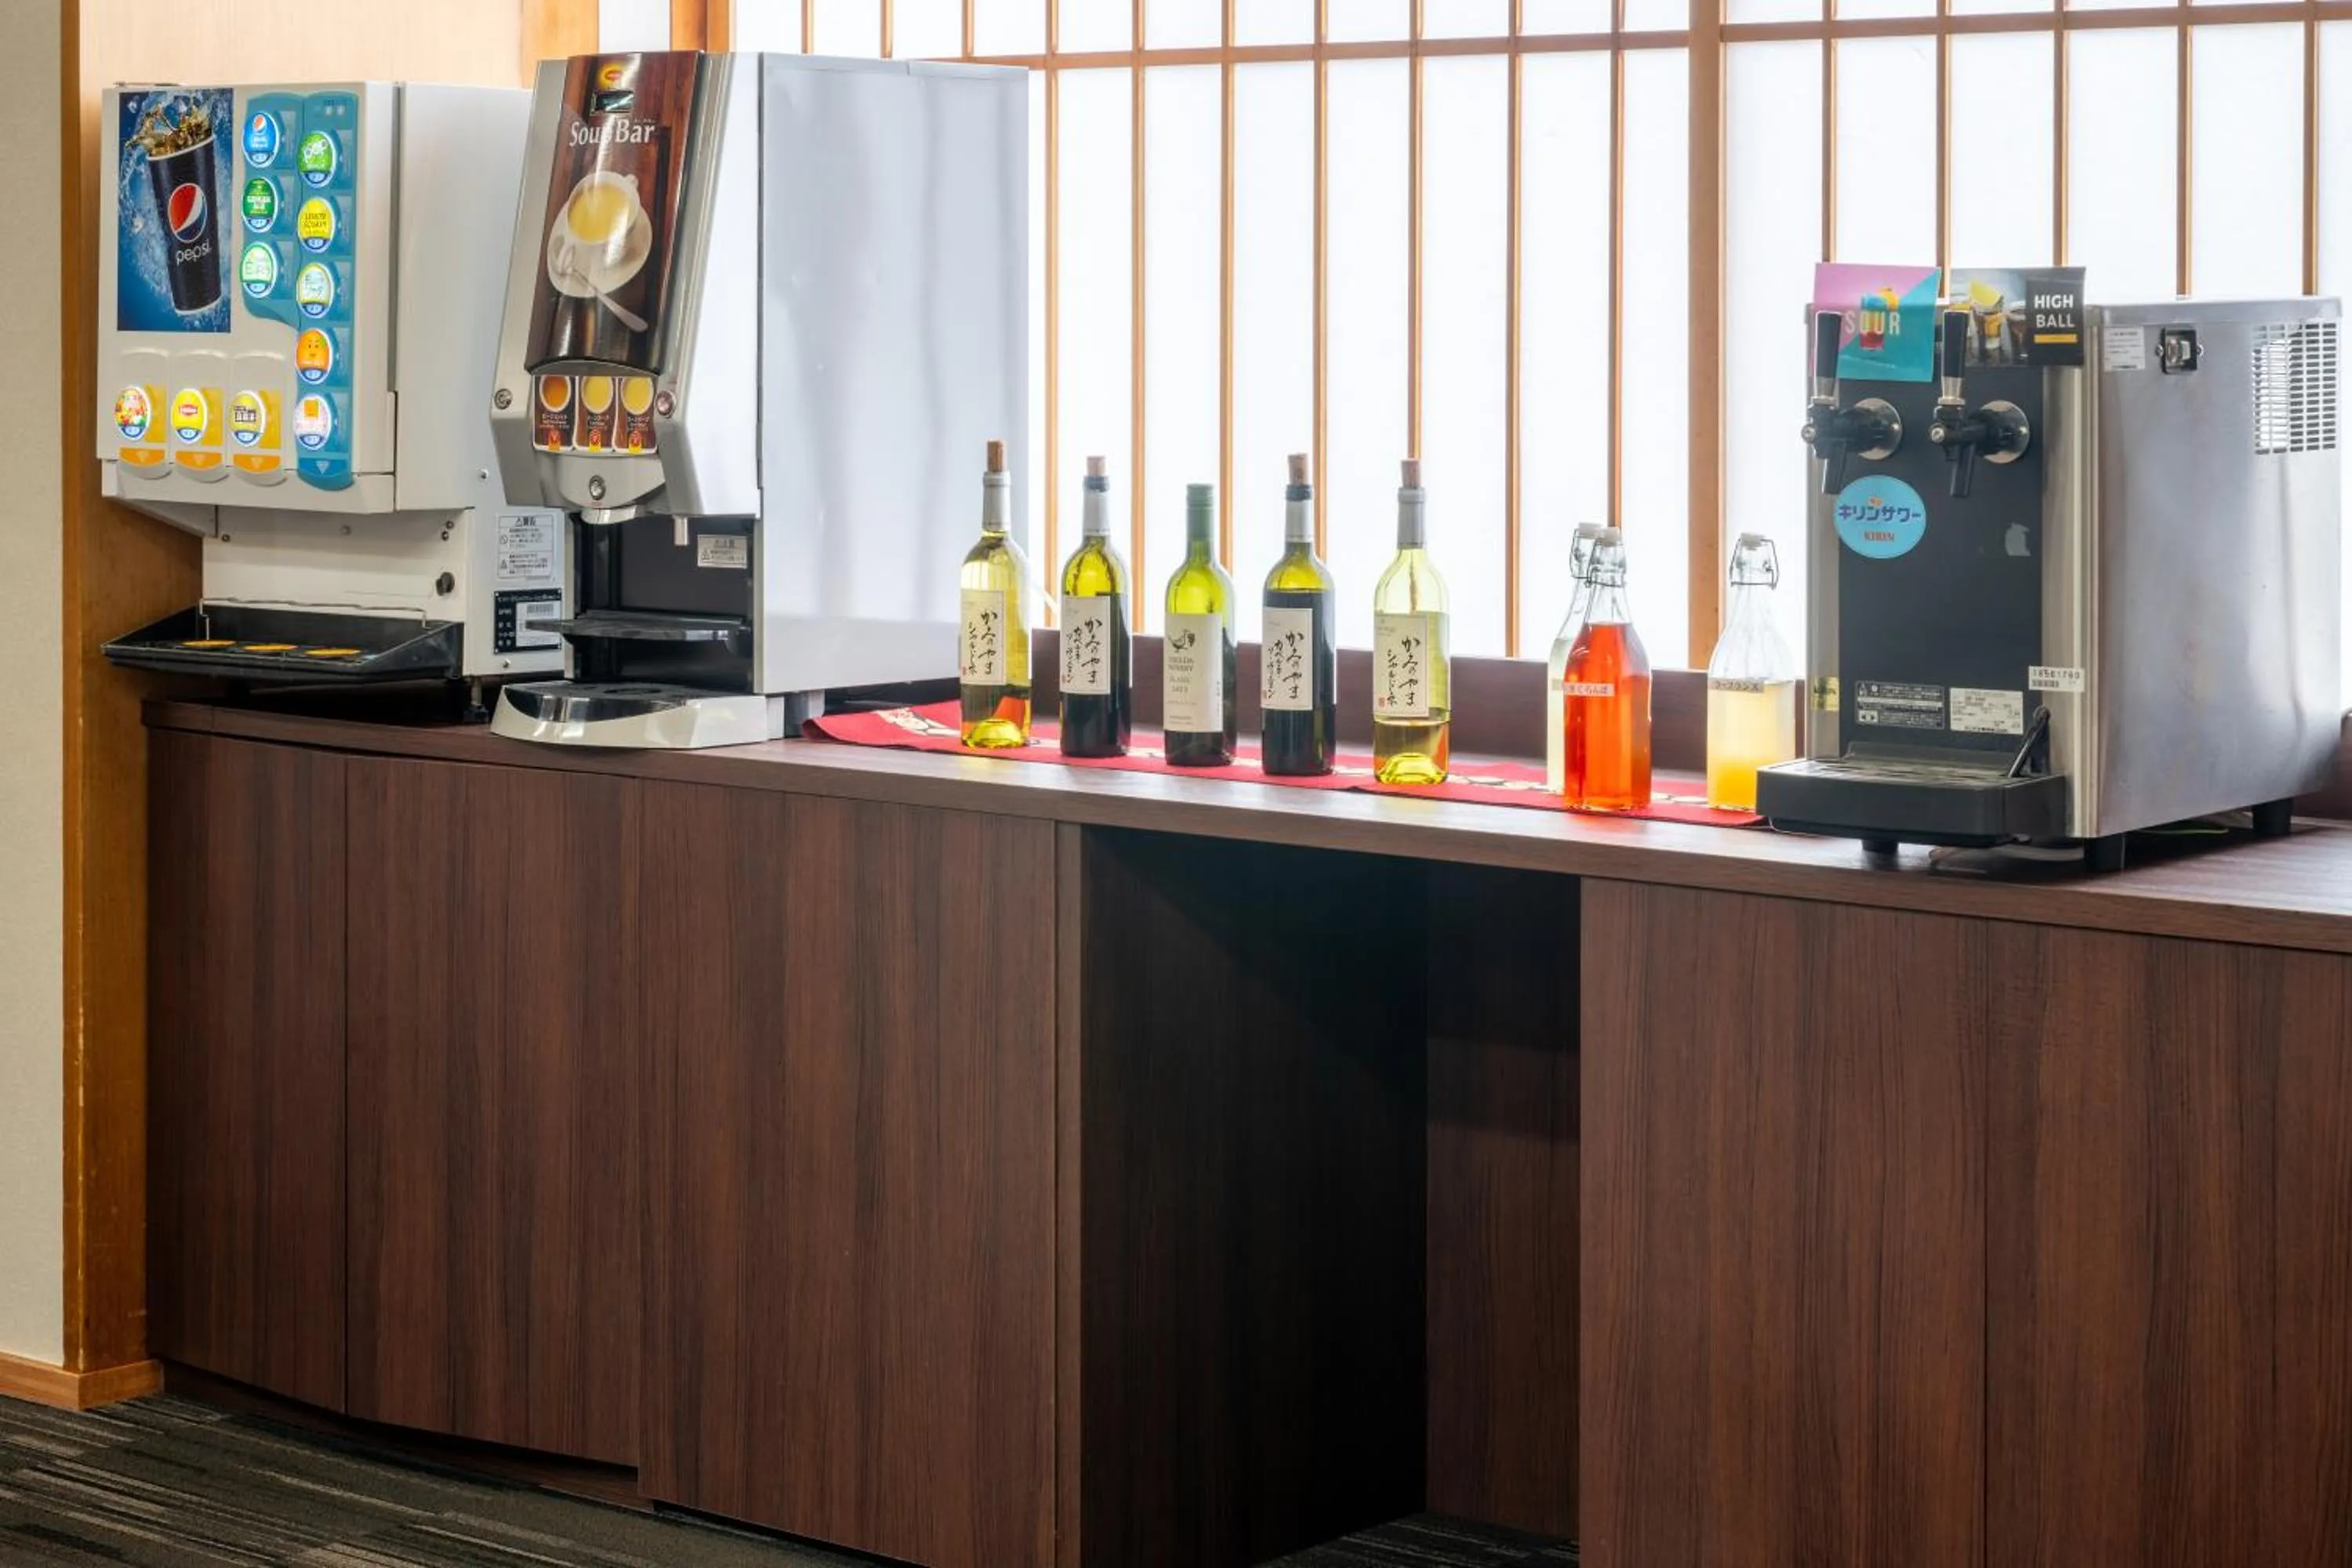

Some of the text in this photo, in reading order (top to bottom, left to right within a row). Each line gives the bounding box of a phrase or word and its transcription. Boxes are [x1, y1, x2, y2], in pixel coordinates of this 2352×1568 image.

[568, 119, 655, 147] Sou Bar
[176, 238, 210, 267] pepsi
[2034, 294, 2074, 309] HIGH
[1845, 310, 1901, 336] SOUR
[2035, 314, 2076, 328] BALL
[1837, 504, 1922, 523] キリンサワー
[1081, 617, 1103, 684] かみのやま
[1283, 631, 1305, 699] かみのやま
[1398, 636, 1421, 706] かみのやま
